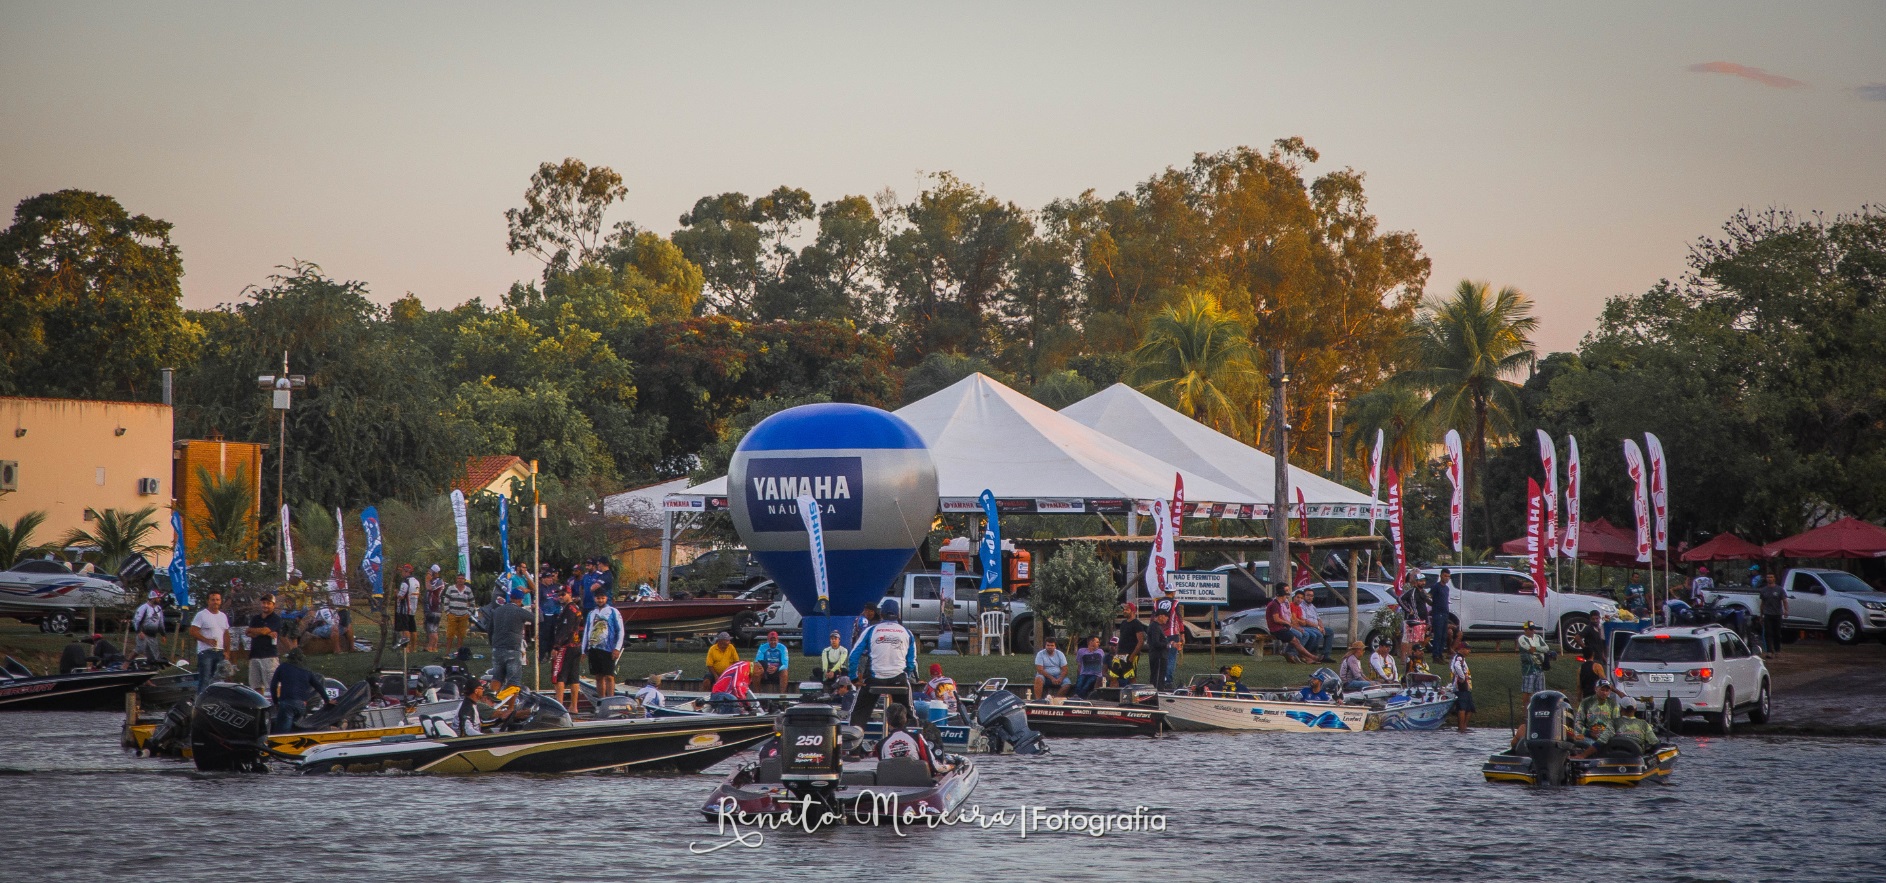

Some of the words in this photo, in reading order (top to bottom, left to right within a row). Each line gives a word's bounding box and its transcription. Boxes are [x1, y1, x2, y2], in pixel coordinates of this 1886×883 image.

[753, 476, 850, 500] YAMAHA
[768, 504, 836, 515] NÁUCA
[201, 701, 255, 729] 400
[940, 730, 964, 739] efort
[796, 735, 823, 746] 250
